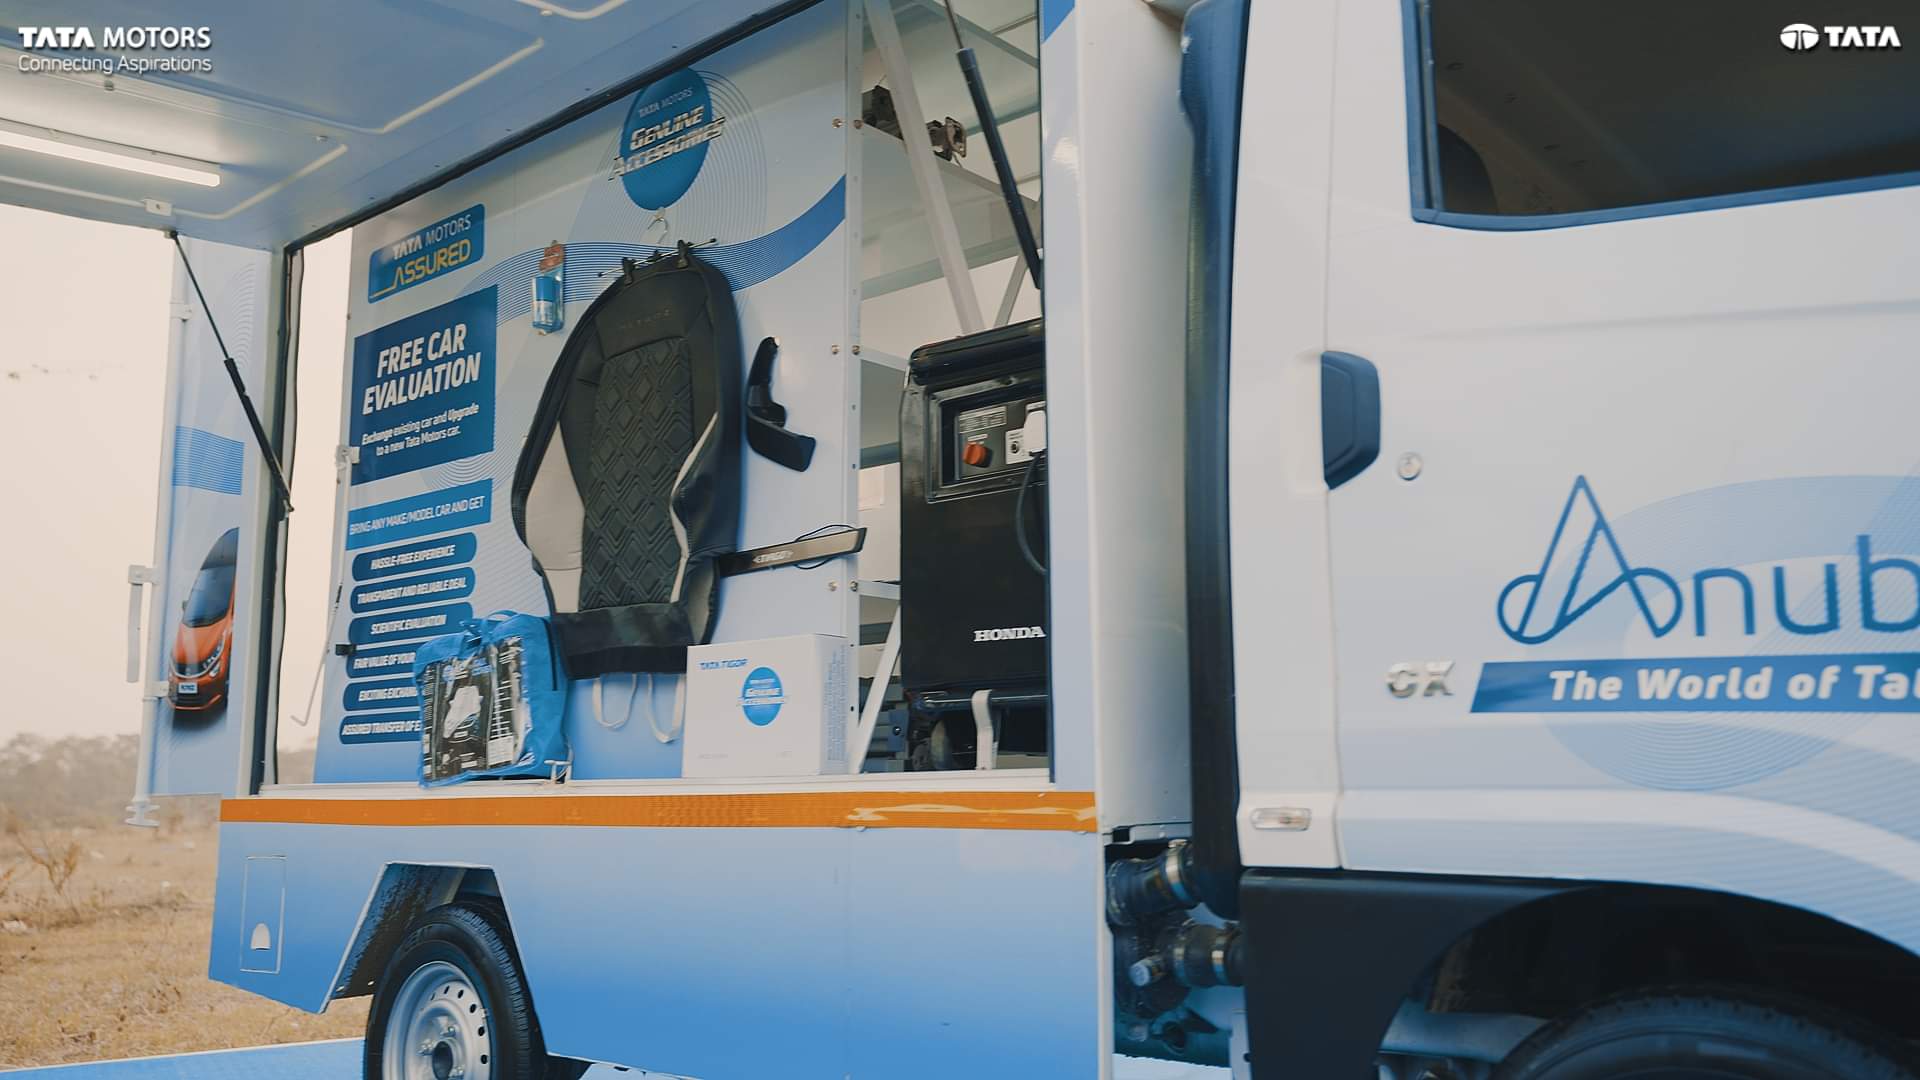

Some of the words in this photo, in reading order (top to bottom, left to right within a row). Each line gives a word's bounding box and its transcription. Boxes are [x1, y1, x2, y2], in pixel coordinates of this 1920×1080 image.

[639, 102, 660, 118] TATA
[661, 87, 693, 107] MOTORS
[392, 234, 423, 260] TATA
[425, 213, 472, 247] MOTORS
[371, 239, 472, 297] ASSURED
[376, 336, 425, 379] FREE
[426, 323, 468, 361] CAR
[362, 351, 482, 415] EVALUATION
[362, 428, 393, 446] Exchange
[393, 421, 420, 437] existing
[420, 417, 433, 429] car
[432, 410, 447, 426] and
[447, 402, 480, 423] Upgrade
[375, 445, 384, 457] to
[389, 440, 406, 453] new
[405, 436, 420, 449] Tata
[420, 429, 447, 445] Motors
[447, 425, 462, 438] car.
[349, 520, 372, 536] BRING
[371, 516, 387, 531] ANY
[434, 503, 452, 518] CAR
[451, 499, 469, 514] AND
[468, 495, 486, 510] GET
[973, 625, 1047, 642] HONDA
[1548, 669, 1623, 701] The
[1636, 666, 1773, 701] World
[1787, 664, 1841, 700] of
